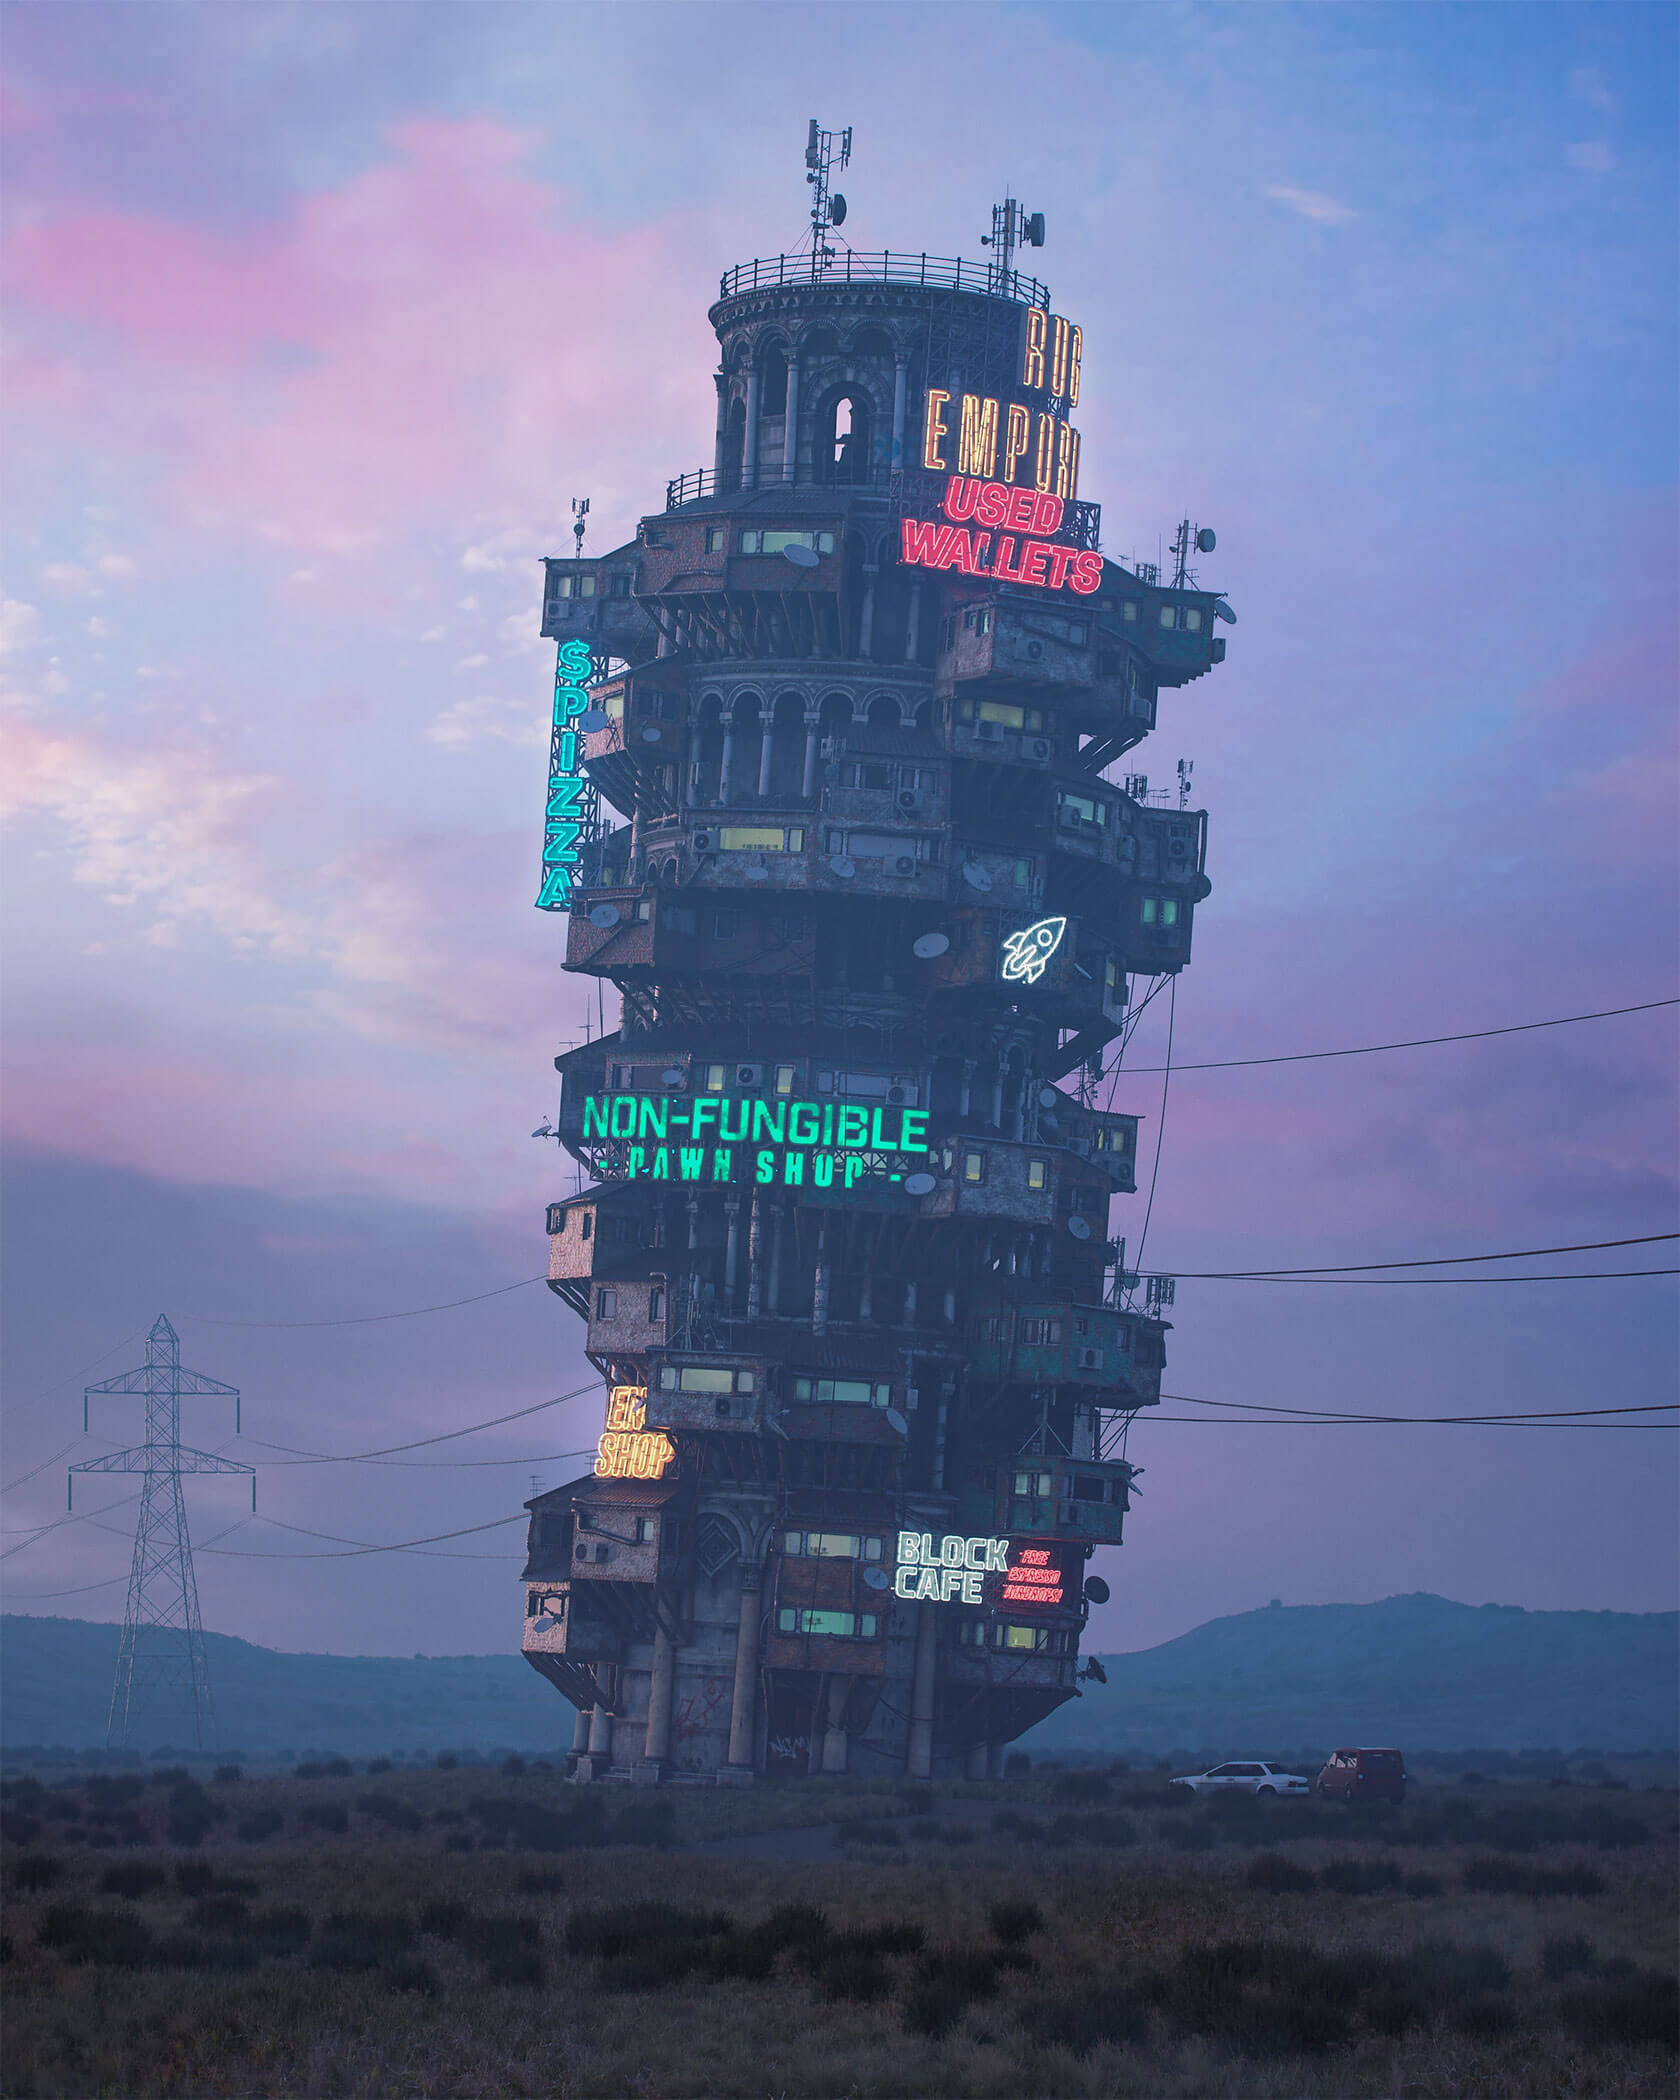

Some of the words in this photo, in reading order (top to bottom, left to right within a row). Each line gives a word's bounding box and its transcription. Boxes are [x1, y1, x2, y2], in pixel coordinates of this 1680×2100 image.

[1023, 306, 1082, 407] RUG
[943, 476, 1064, 537] USED
[902, 519, 1104, 595] WALLETS
[583, 1096, 930, 1153] NON-FUNGIBLE
[628, 1146, 732, 1182] PAWN
[755, 1150, 864, 1189] SHOP
[594, 1432, 676, 1480] SHOP
[897, 1531, 1009, 1572] BLOCK
[895, 1566, 985, 1604] CAFE
[1007, 1567, 1062, 1585] ESPRESSO
